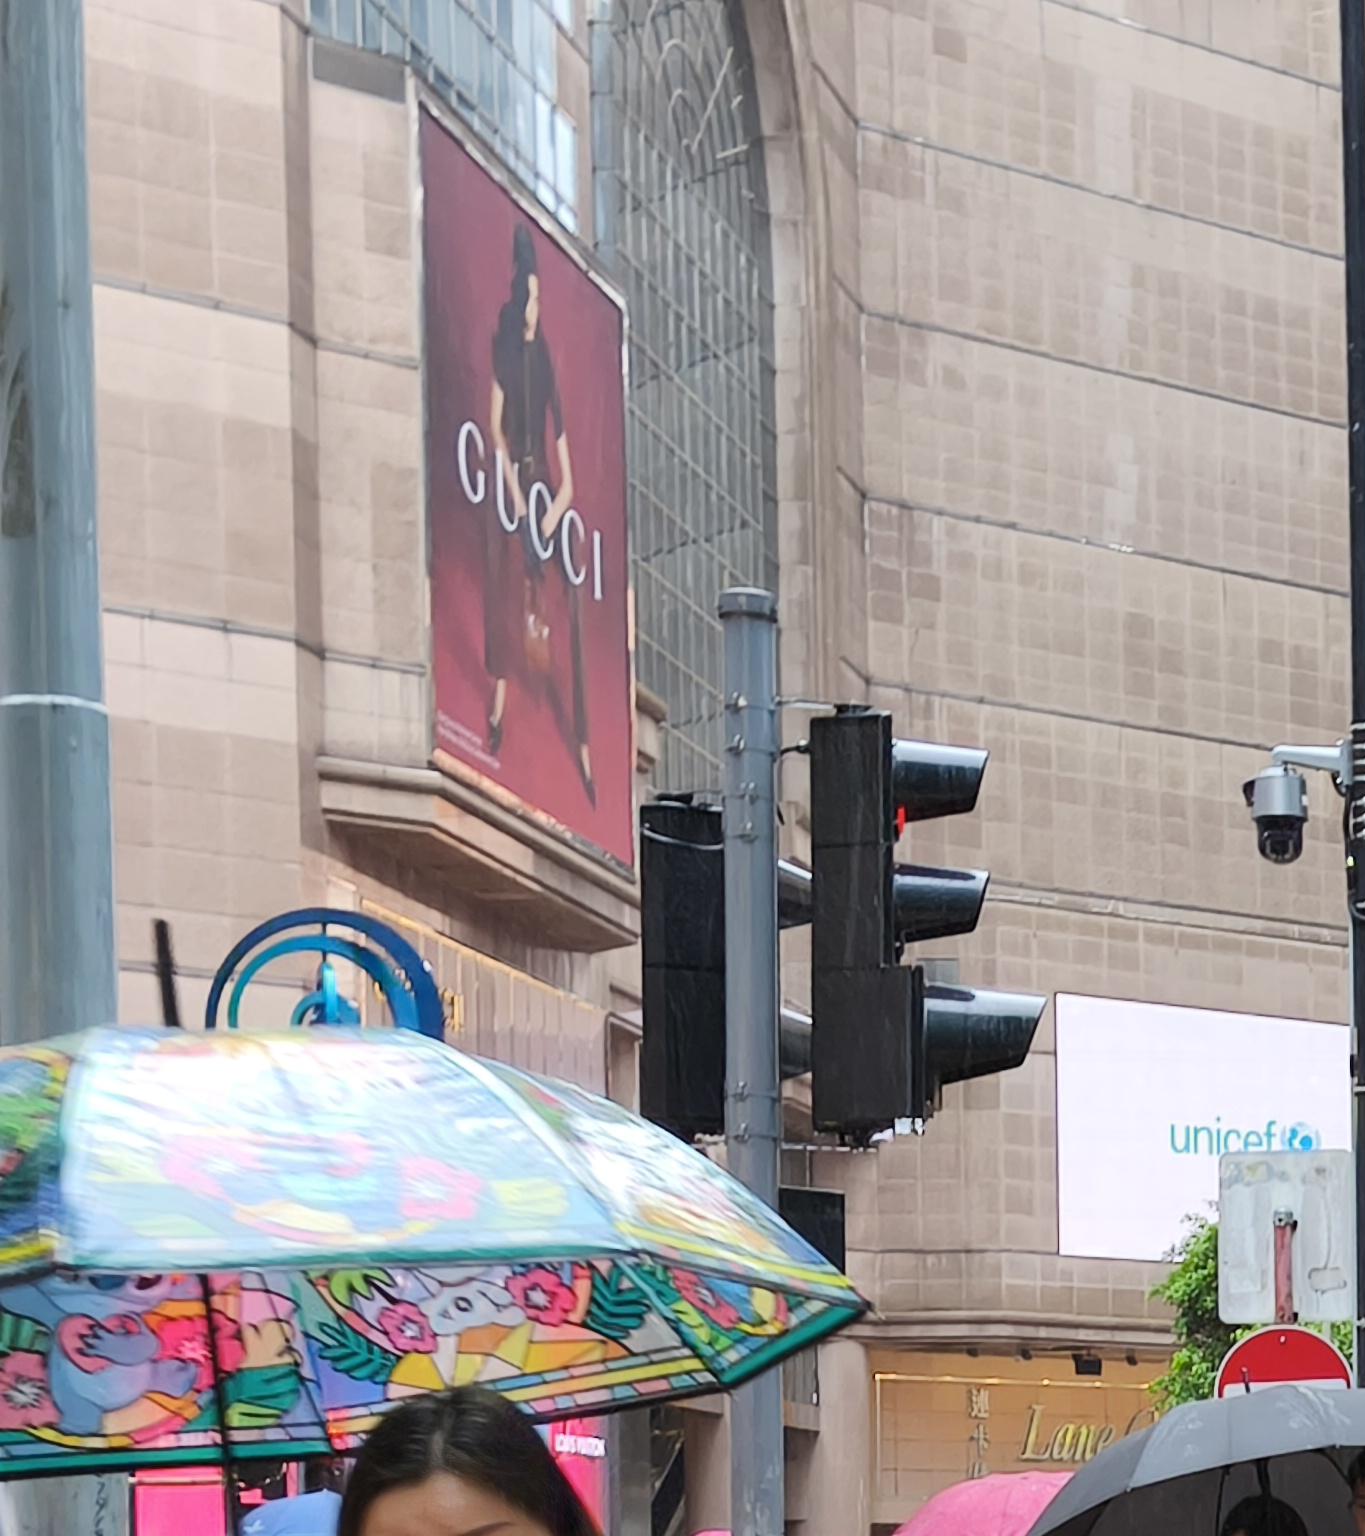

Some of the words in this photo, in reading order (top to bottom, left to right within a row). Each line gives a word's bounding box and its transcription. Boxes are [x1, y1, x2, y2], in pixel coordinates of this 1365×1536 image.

[457, 420, 603, 602] GUCCI
[1170, 1116, 1277, 1155] unicef
[1018, 1403, 1116, 1462] Lane
